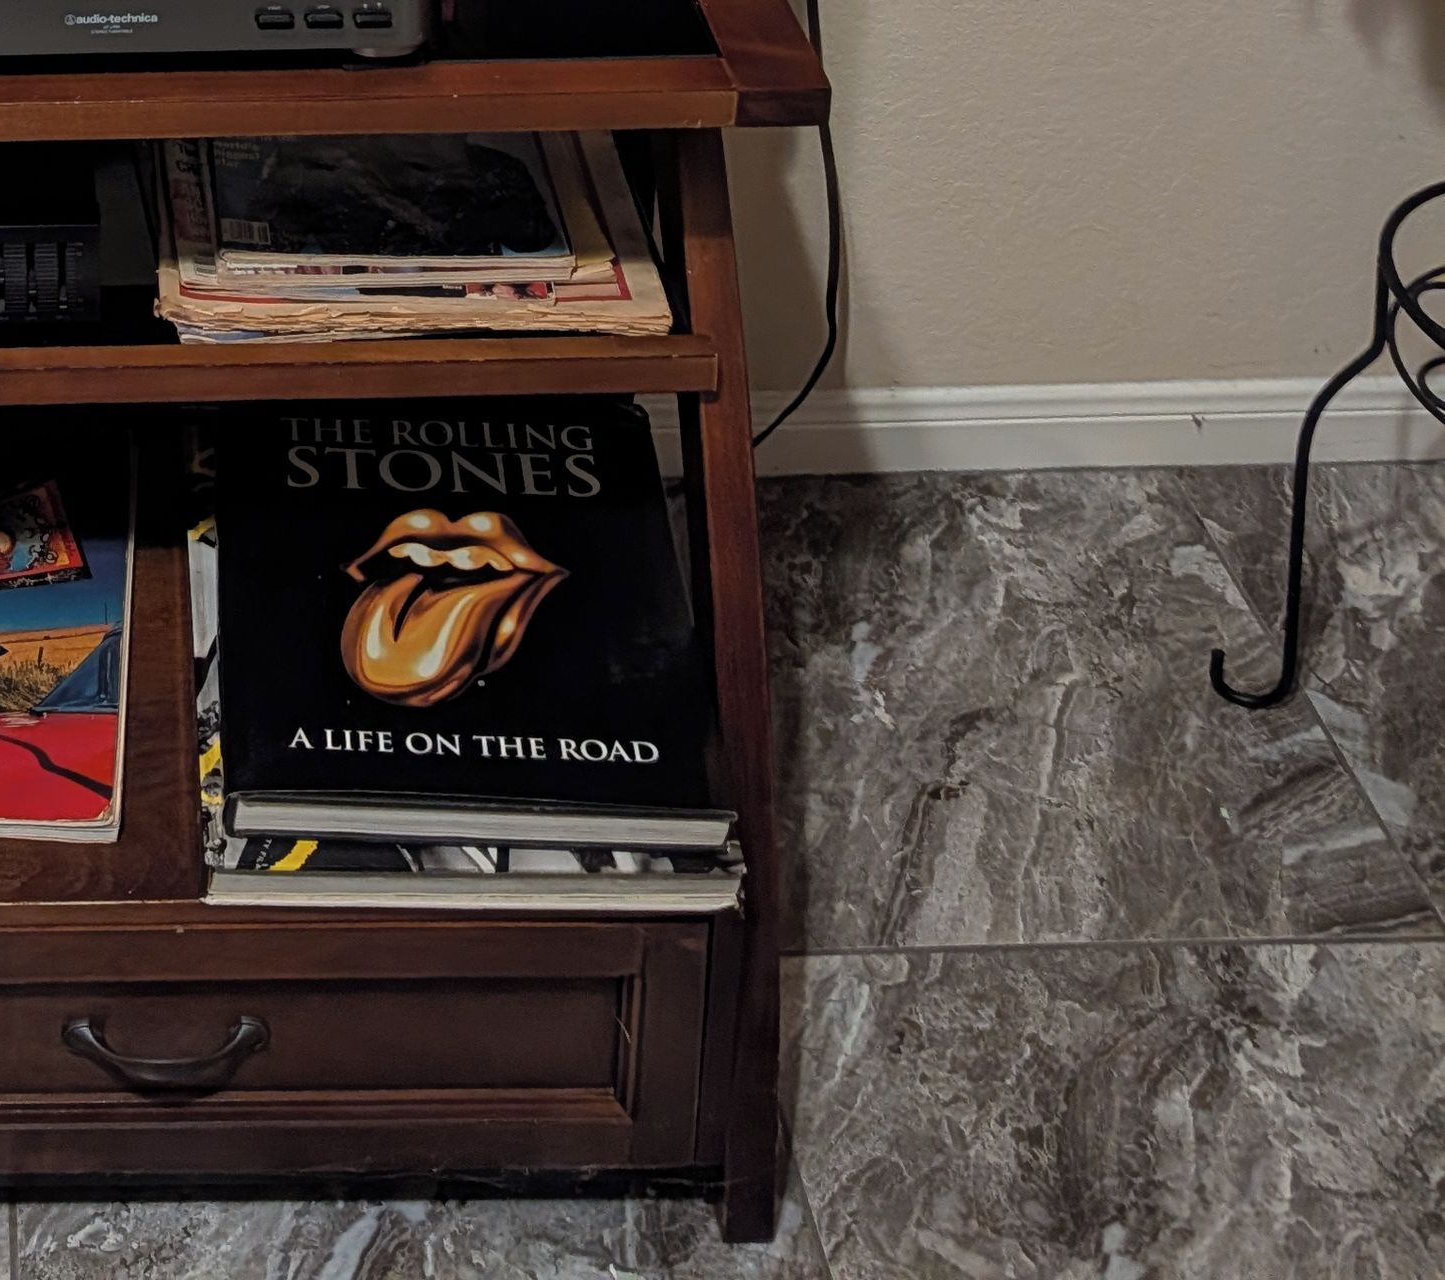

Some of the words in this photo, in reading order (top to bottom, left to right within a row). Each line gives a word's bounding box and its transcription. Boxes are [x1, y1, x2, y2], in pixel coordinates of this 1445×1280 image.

[75, 12, 159, 25] audio-technica
[280, 415, 372, 444] THE
[391, 419, 594, 451] ROLLING
[286, 445, 603, 498] STONES
[289, 727, 314, 749] A
[325, 729, 393, 753] LIFE
[405, 732, 461, 757] ON
[472, 734, 547, 760] THE
[560, 738, 659, 764] ROAD
